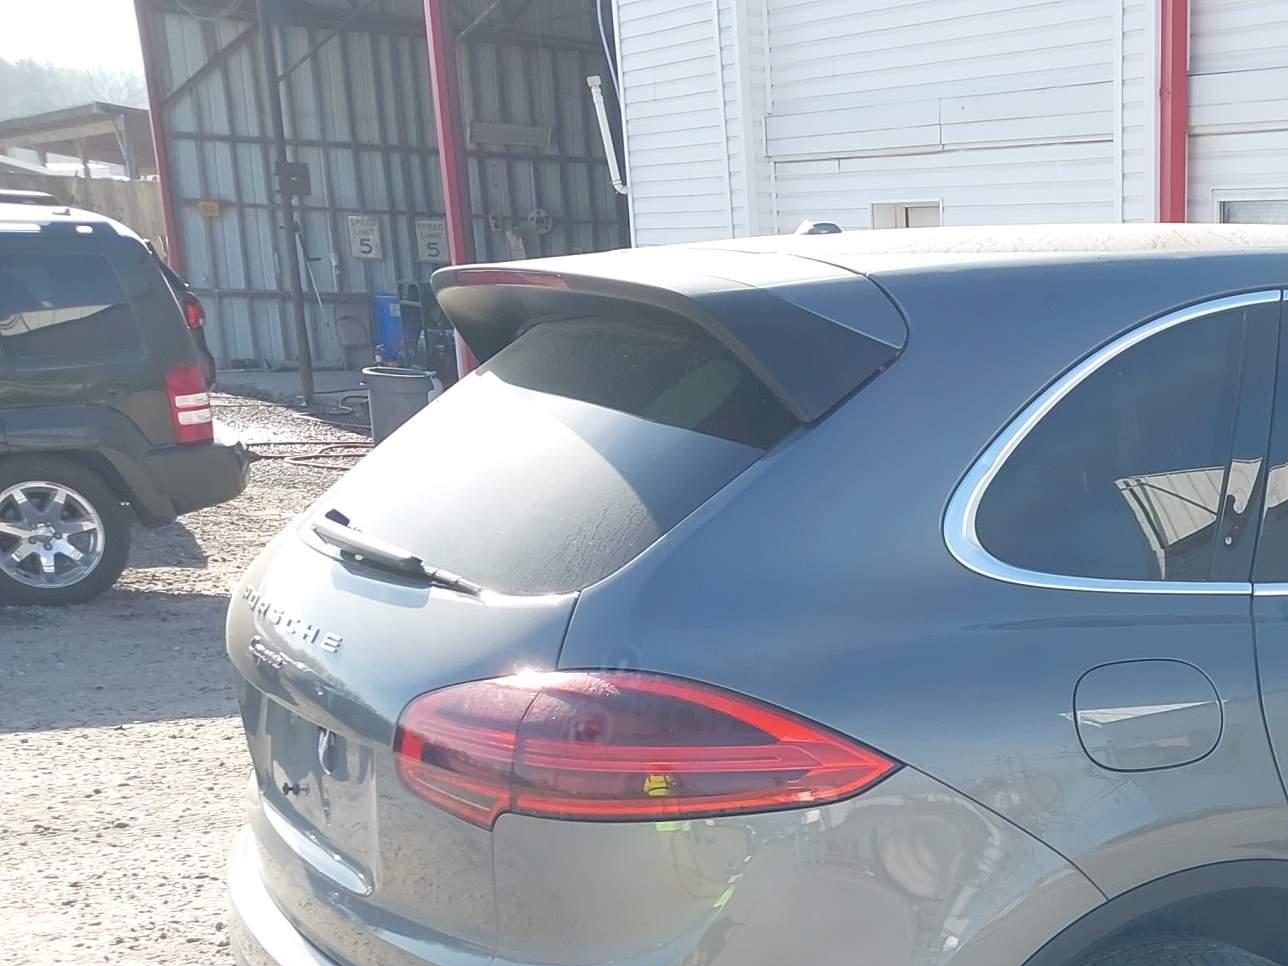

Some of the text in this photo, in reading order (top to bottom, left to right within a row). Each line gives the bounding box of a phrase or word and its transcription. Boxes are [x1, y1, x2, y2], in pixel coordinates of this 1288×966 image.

[416, 222, 444, 231] SPEED
[359, 238, 372, 254] 5
[427, 242, 440, 257] 5
[242, 584, 344, 655] PORSCHE
